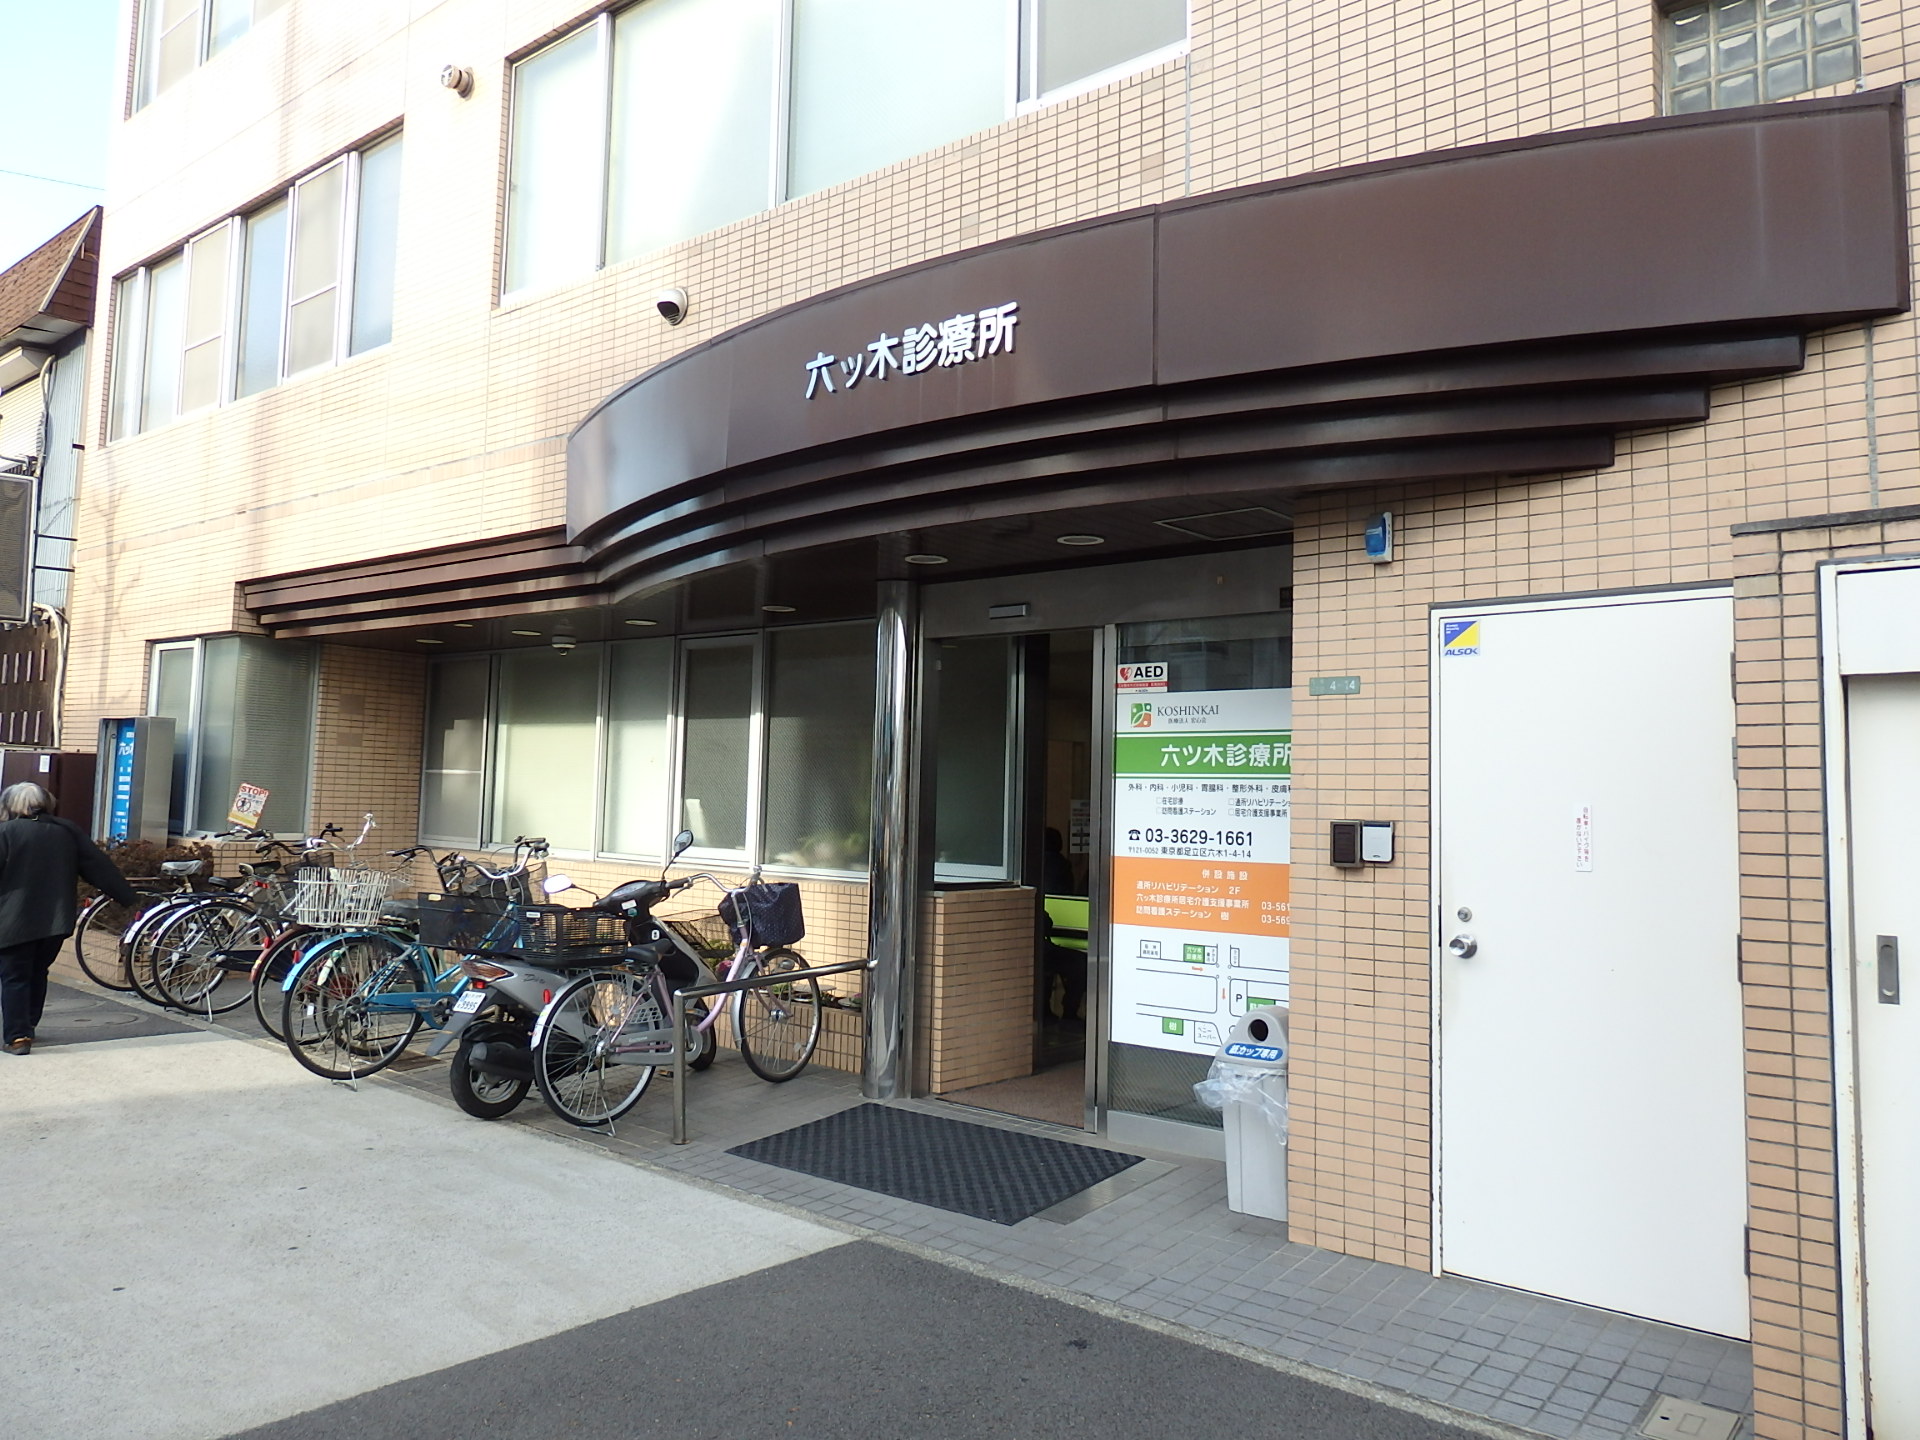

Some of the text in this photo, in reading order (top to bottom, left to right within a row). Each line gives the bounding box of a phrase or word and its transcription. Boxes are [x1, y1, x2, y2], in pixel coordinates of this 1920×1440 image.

[1445, 648, 1478, 656] ALSOK
[1134, 666, 1163, 678] AED
[1157, 705, 1219, 716] KOSHINKAI
[1145, 828, 1253, 846] 03-3629-1661
[1136, 881, 1241, 895] 通所リハビリテーション 2F
[1136, 905, 1212, 919] 訪問看護ステーション
[1235, 994, 1243, 1003] P
[1229, 1045, 1279, 1059] 紙カップ専用
